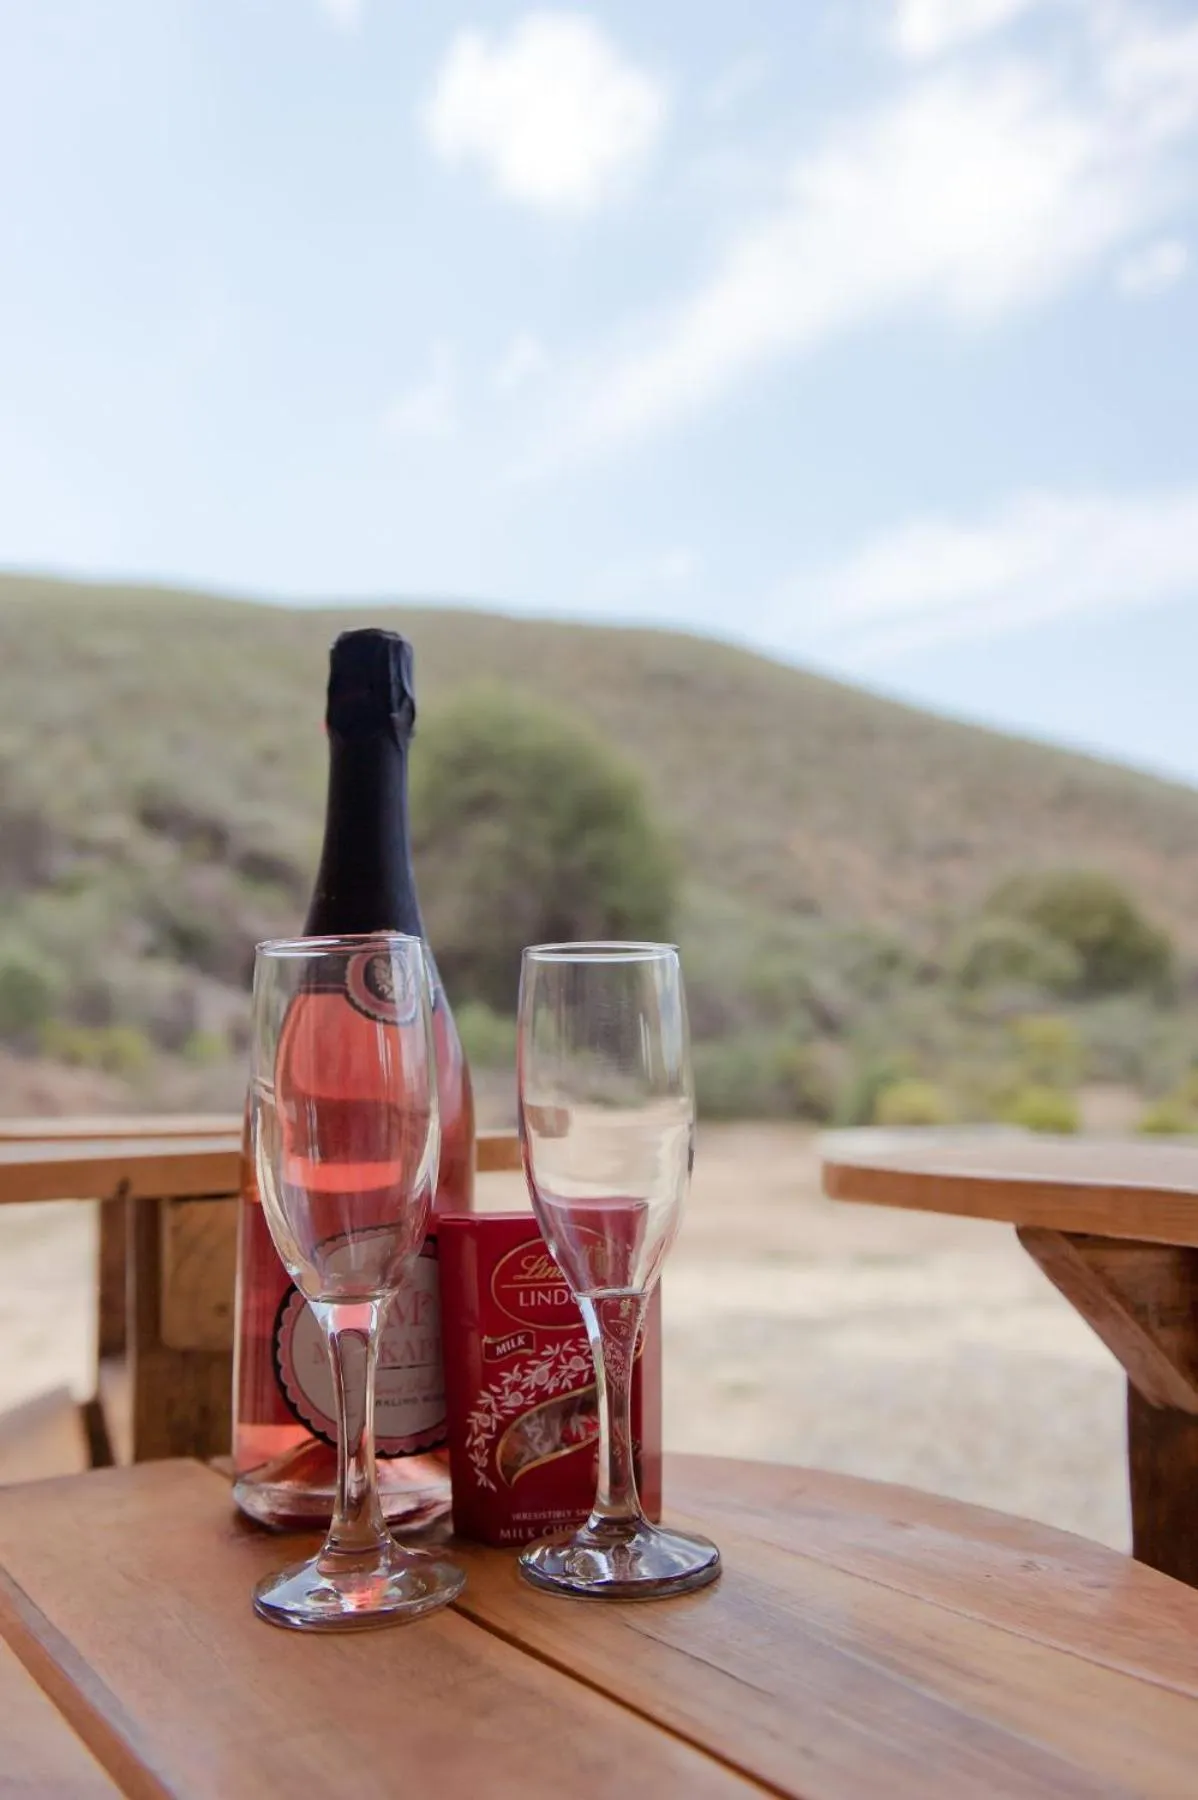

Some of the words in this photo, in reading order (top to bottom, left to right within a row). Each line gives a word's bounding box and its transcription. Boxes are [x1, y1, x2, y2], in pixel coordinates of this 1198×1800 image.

[519, 1289, 576, 1307] LIND
[496, 1335, 526, 1356] MILK
[500, 1527, 536, 1540] MILK
